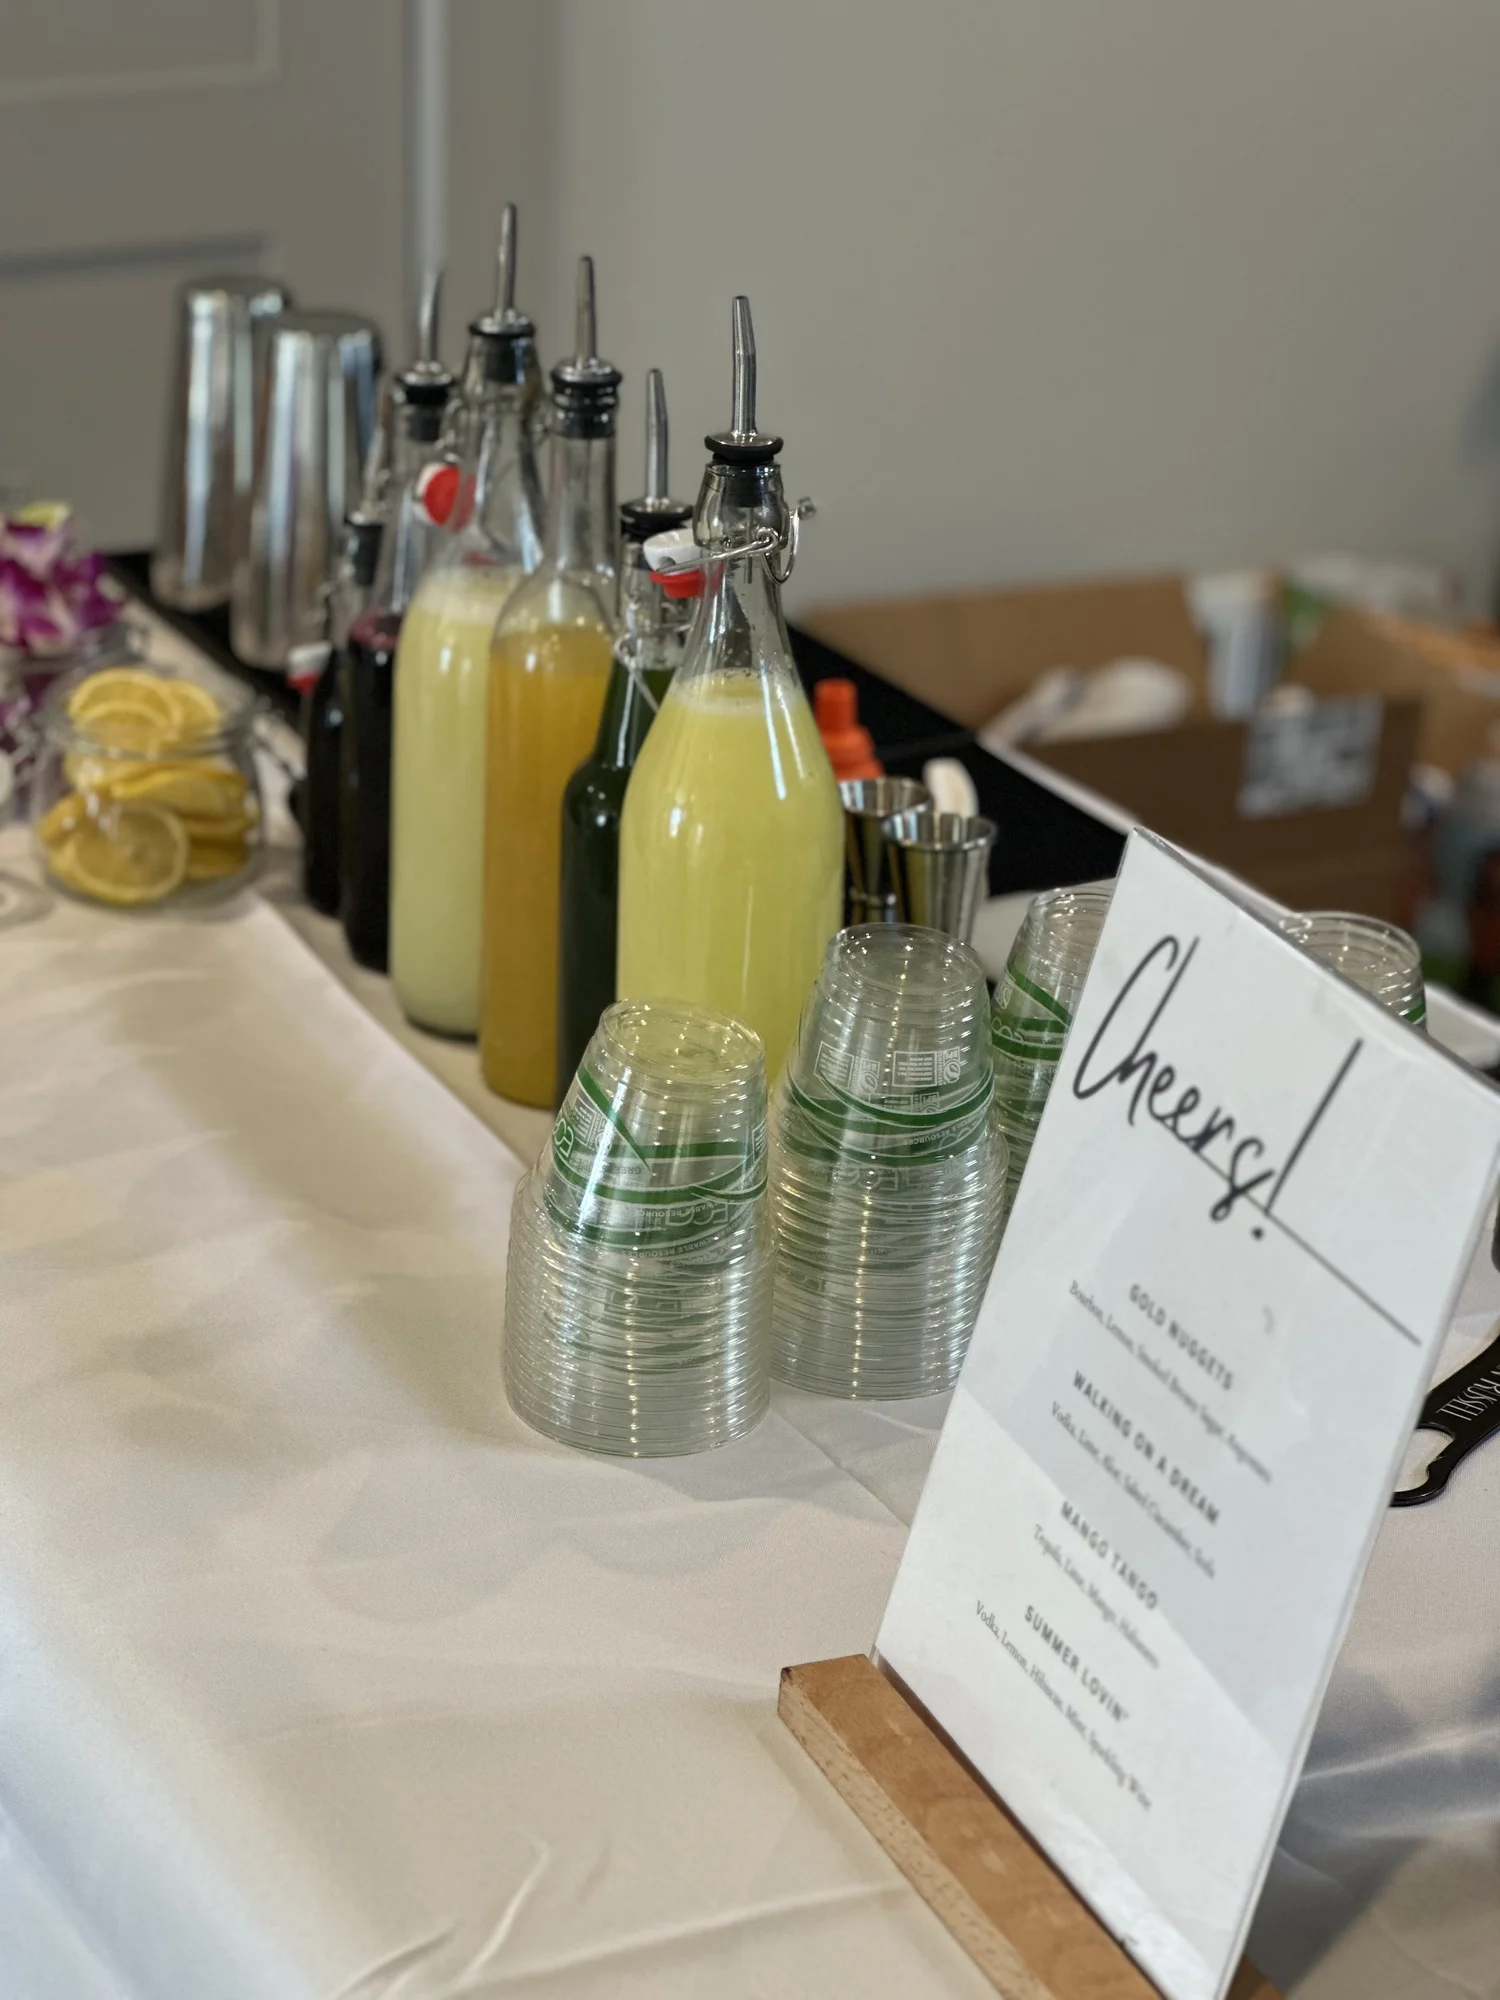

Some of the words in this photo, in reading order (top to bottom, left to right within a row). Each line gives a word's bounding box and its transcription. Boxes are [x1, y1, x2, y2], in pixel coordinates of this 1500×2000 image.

[1072, 935, 1364, 1241] Cheers!
[1129, 1284, 1165, 1326] GOLD
[1168, 1321, 1232, 1389] NUGGETS
[1074, 1371, 1130, 1437] WALKING
[1134, 1432, 1154, 1459] ON
[1156, 1456, 1166, 1473] A
[1169, 1468, 1218, 1523] DREAM
[1061, 1501, 1108, 1557] MANGO
[1112, 1550, 1159, 1609] TANGO
[976, 1600, 999, 1639] Vodka,
[1001, 1631, 1027, 1672] Lemon,
[1025, 1606, 1078, 1671] SUMMER
